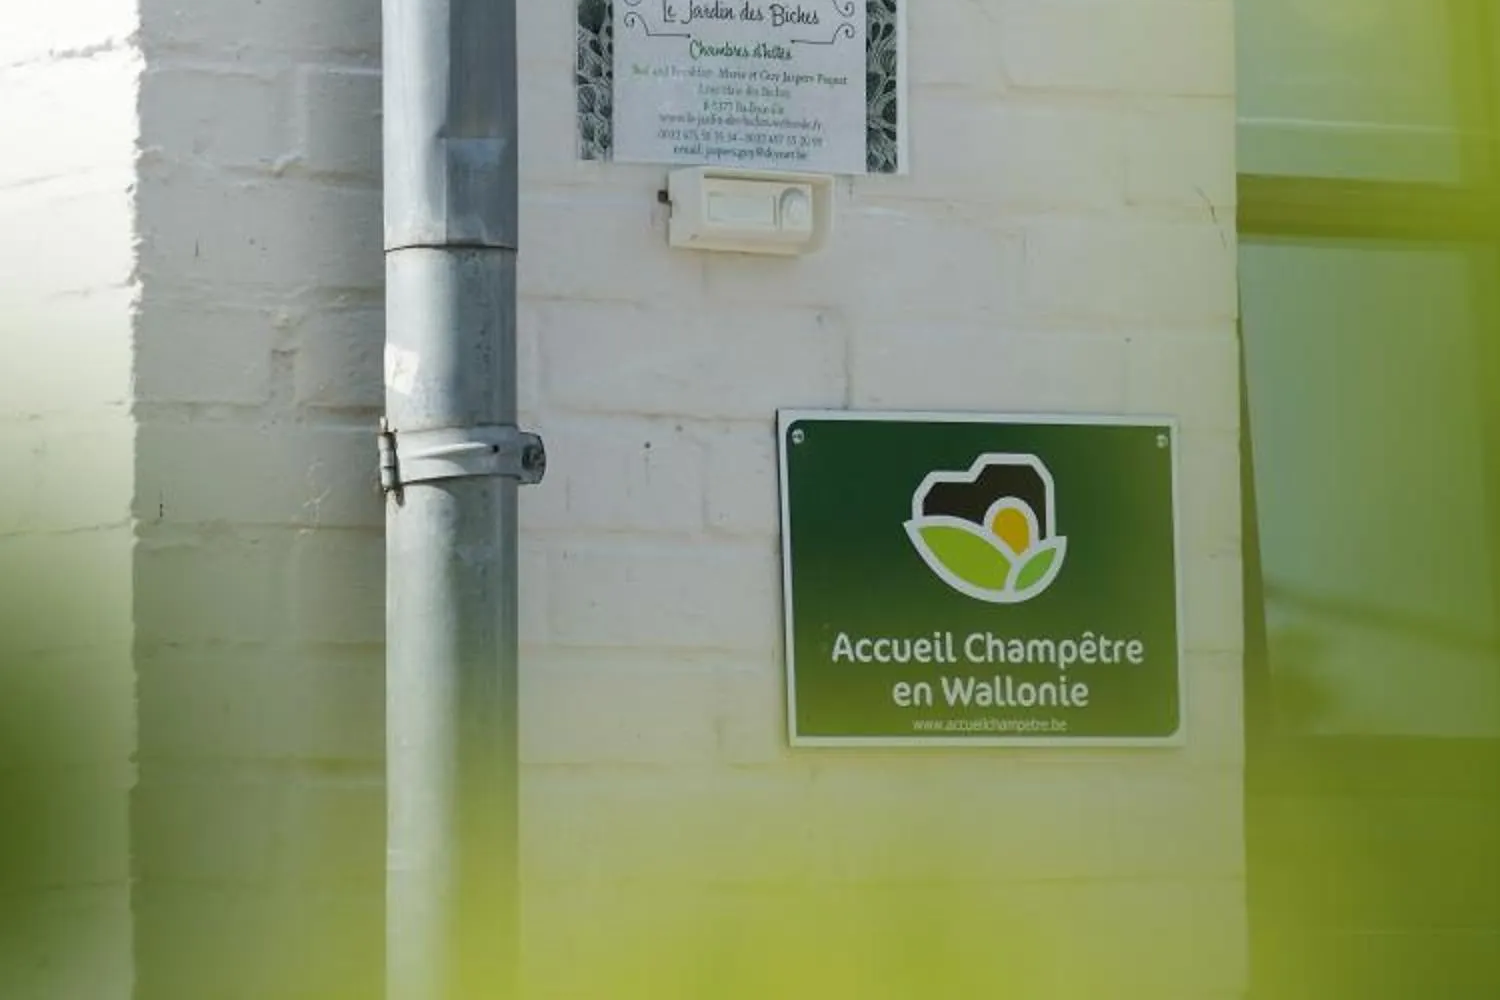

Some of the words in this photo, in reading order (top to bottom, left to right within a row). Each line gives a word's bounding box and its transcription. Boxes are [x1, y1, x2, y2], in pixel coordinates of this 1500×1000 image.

[739, 0, 764, 21] des
[770, 2, 820, 27] Biches
[831, 632, 957, 664] Accueil
[964, 631, 1144, 669] Champêtre
[892, 681, 932, 707] en
[941, 676, 1090, 707] Wallonie
